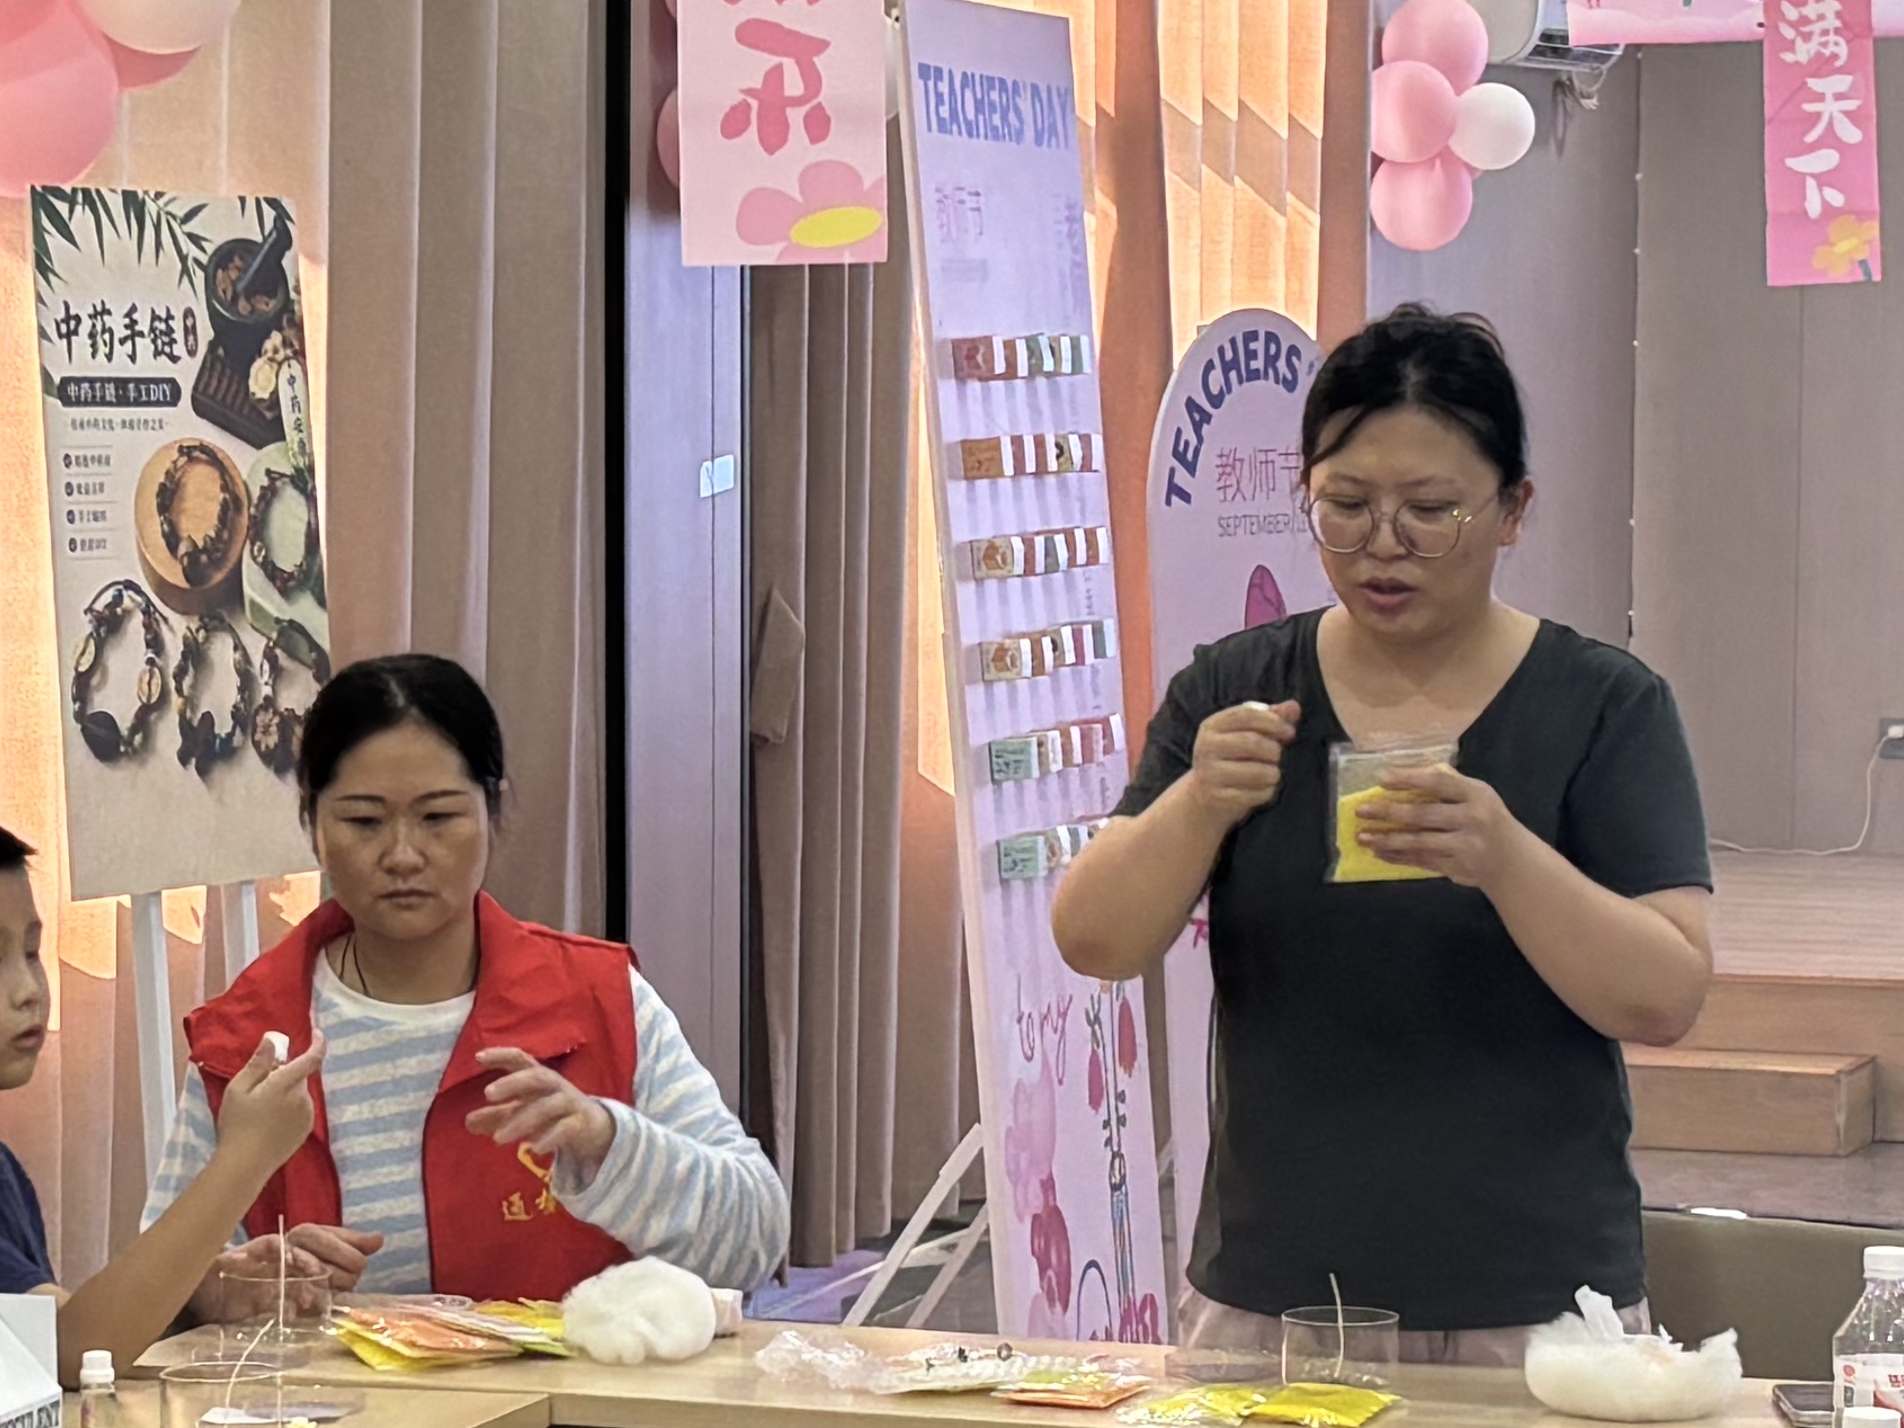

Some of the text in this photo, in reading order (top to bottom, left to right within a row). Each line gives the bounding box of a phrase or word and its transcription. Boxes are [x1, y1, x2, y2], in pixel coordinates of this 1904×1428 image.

[1030, 82, 1071, 149] DAY
[54, 299, 182, 365] 中药手链
